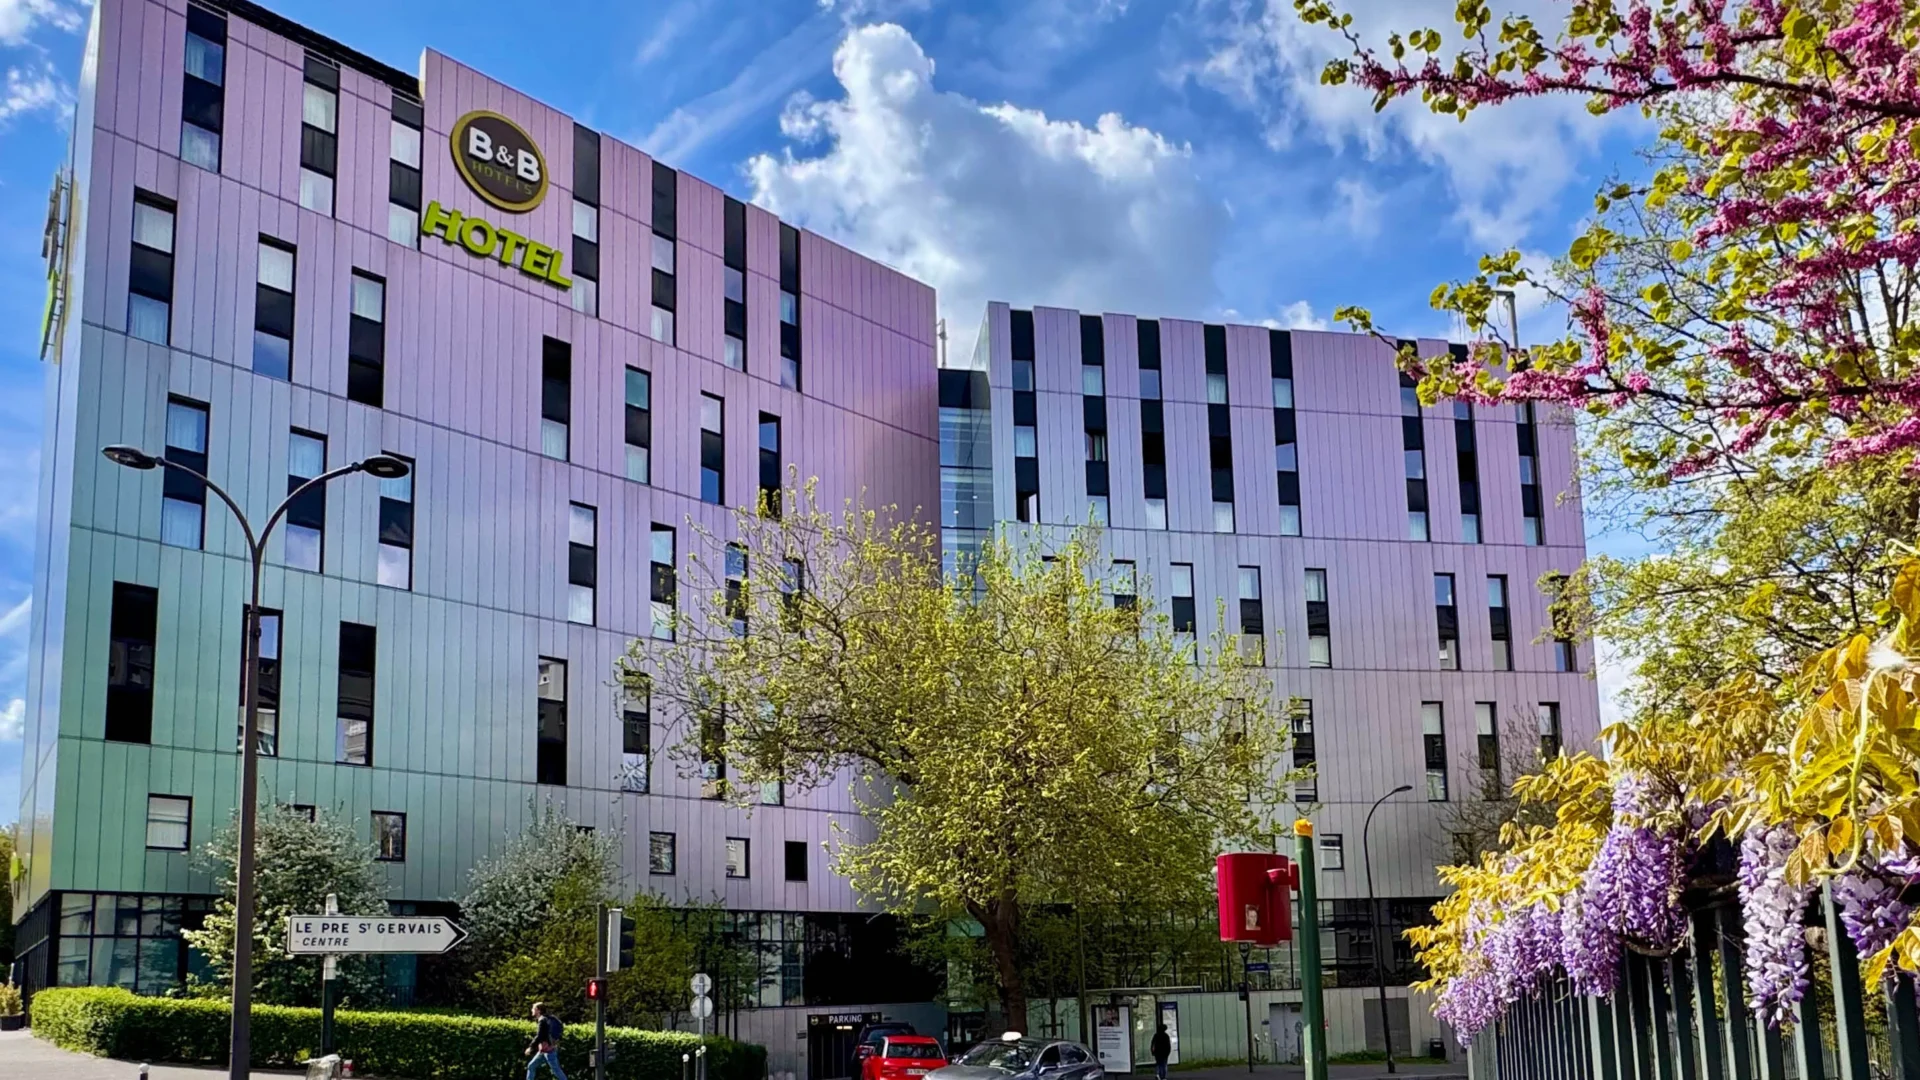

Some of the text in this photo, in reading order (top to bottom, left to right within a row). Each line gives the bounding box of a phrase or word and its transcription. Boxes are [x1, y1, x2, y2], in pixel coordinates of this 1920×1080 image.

[468, 126, 541, 182] B&B
[422, 200, 573, 288] HOTEL
[296, 922, 313, 934] LE
[321, 922, 350, 934] PRE
[377, 922, 442, 934] GERVAIS
[828, 1014, 863, 1024] PARKING
